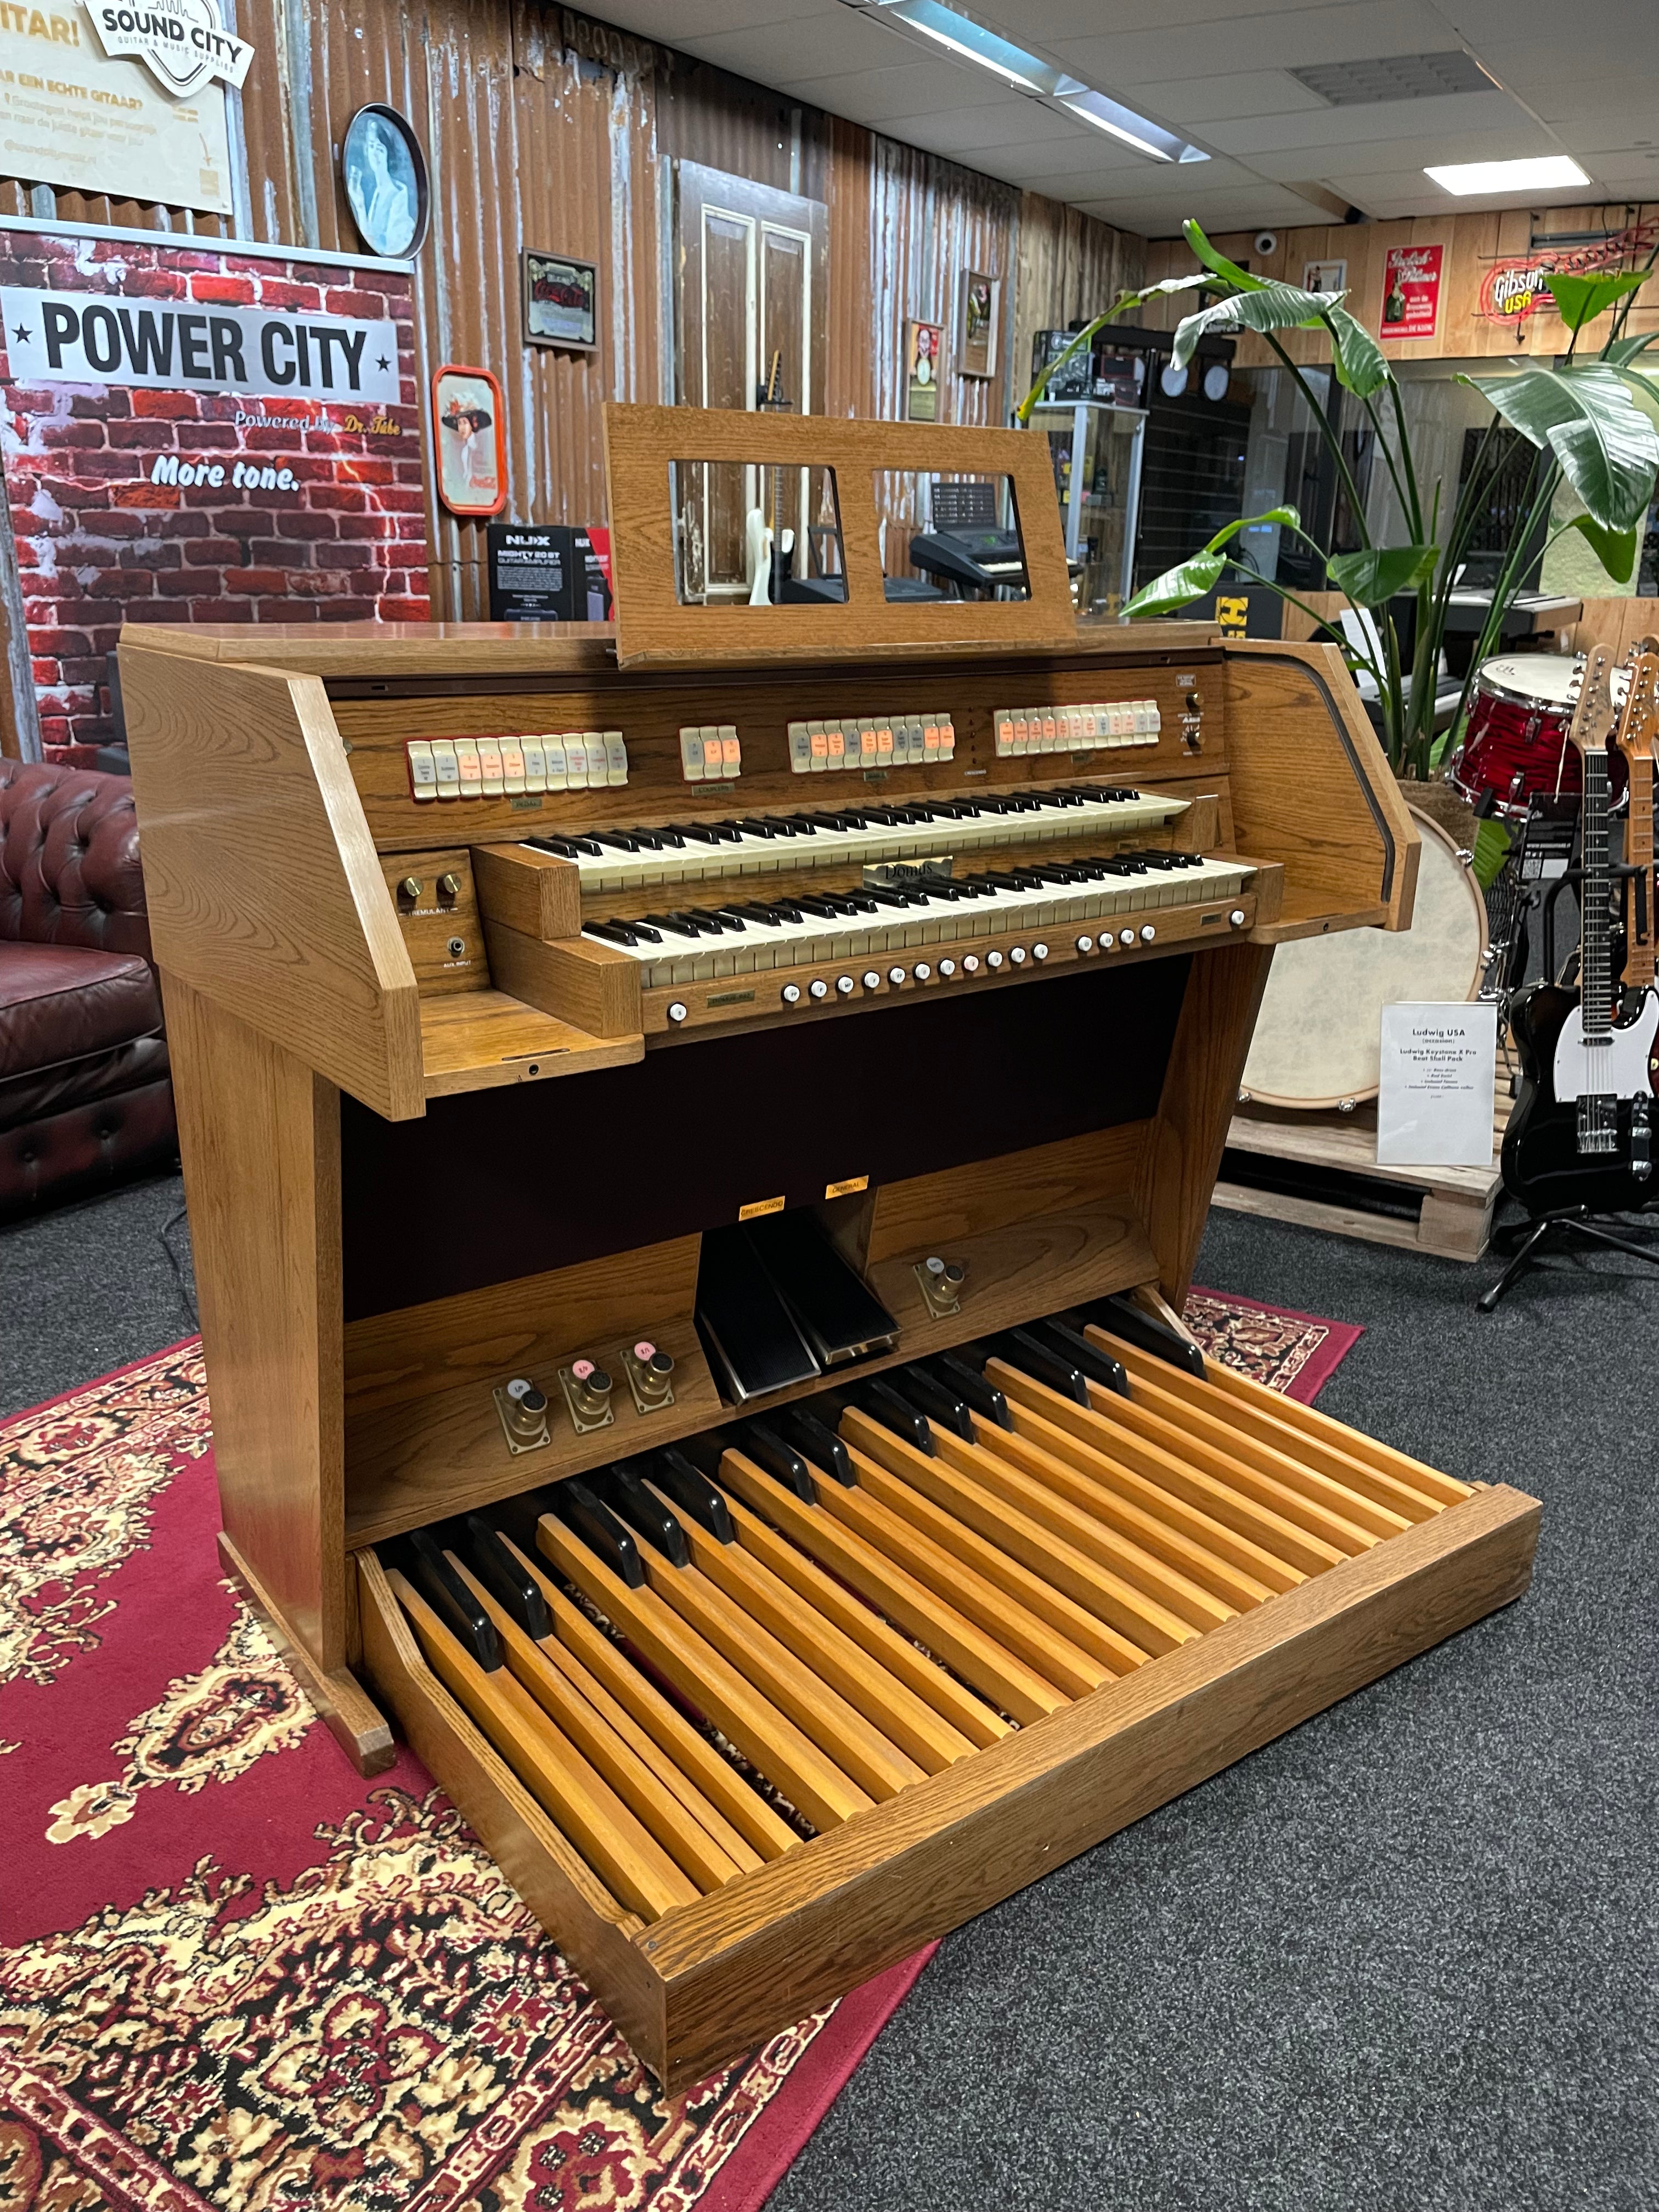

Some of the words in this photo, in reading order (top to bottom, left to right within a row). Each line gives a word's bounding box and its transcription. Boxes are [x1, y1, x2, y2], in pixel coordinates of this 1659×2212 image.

[102, 8, 184, 42] SOUND
[190, 27, 242, 64] CITY
[118, 36, 149, 45] GUITAR
[163, 42, 189, 55] MUSIC
[19, 72, 44, 90] EEN
[47, 79, 88, 98] ECHTE
[1494, 269, 1544, 308] Gibson
[1504, 291, 1532, 314] USA
[41, 301, 249, 383] POWER
[261, 320, 368, 391] CITY
[235, 410, 310, 431] Powered
[315, 415, 336, 434] by
[345, 414, 368, 434] Dr.
[370, 415, 403, 437] Tube
[150, 454, 226, 488] More
[232, 461, 300, 492] tone.
[505, 534, 551, 546] NUX
[885, 863, 933, 879] Domus
[408, 907, 450, 917] TREMULANT
[1412, 1028, 1444, 1038] Ludwig
[1400, 1047, 1424, 1056] Ludwig
[1426, 1048, 1457, 1057] Keystone
[740, 1200, 784, 1217] CRESCENDO
